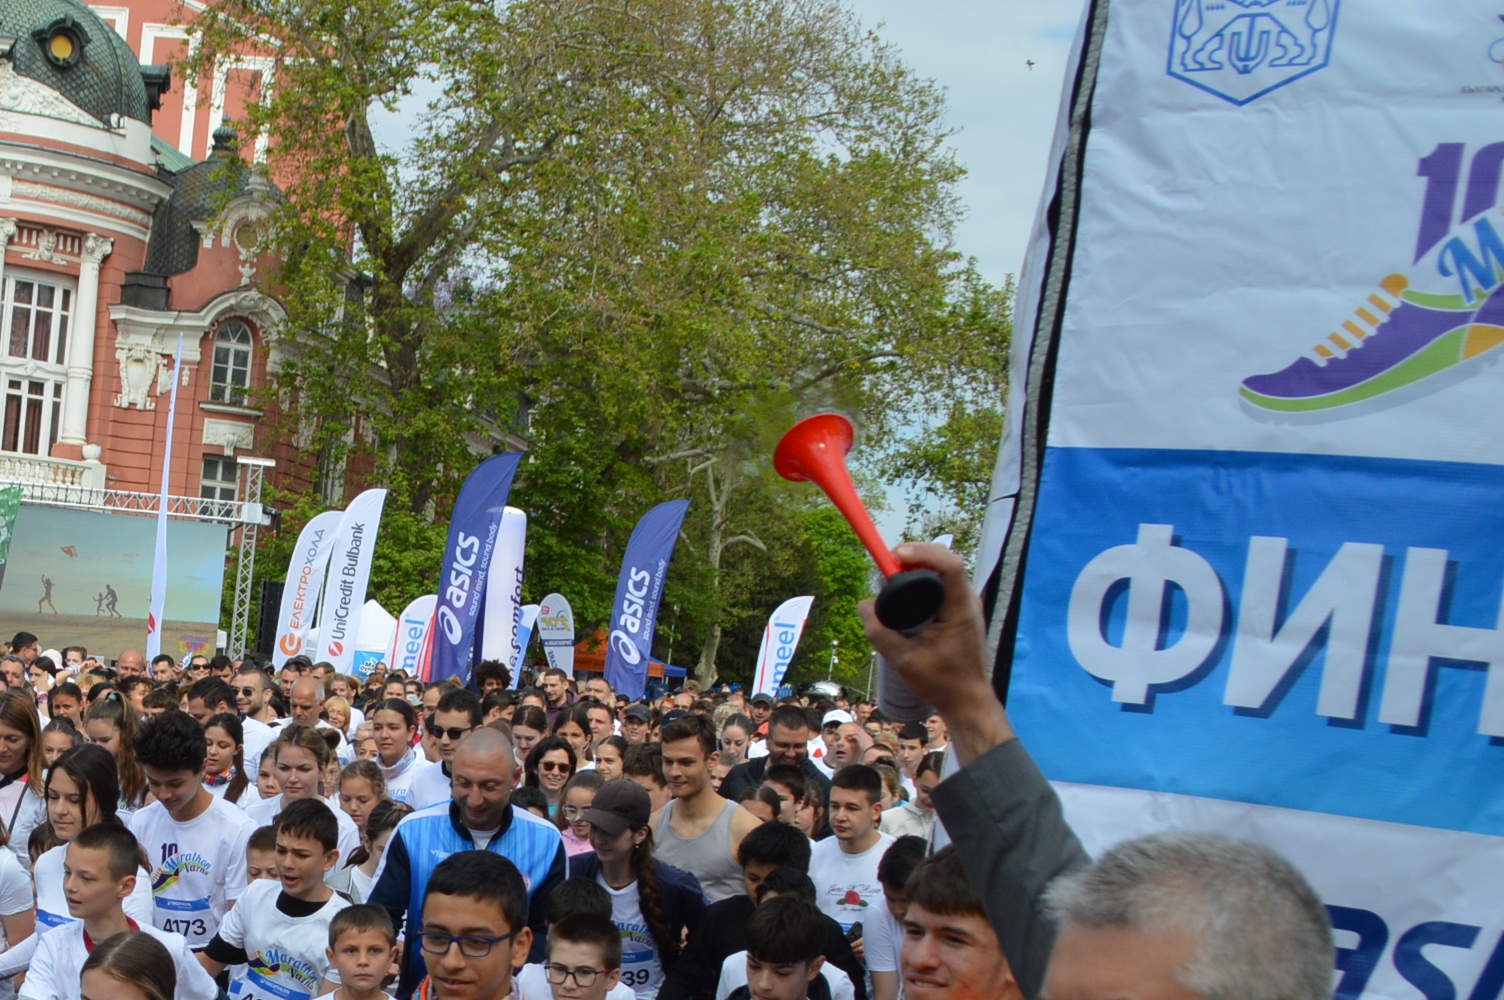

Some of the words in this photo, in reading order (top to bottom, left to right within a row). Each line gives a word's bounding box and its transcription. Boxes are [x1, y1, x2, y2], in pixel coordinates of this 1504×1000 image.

[343, 521, 365, 578] Bulbank
[338, 576, 355, 640] UniCredit
[162, 917, 207, 937] 4173
